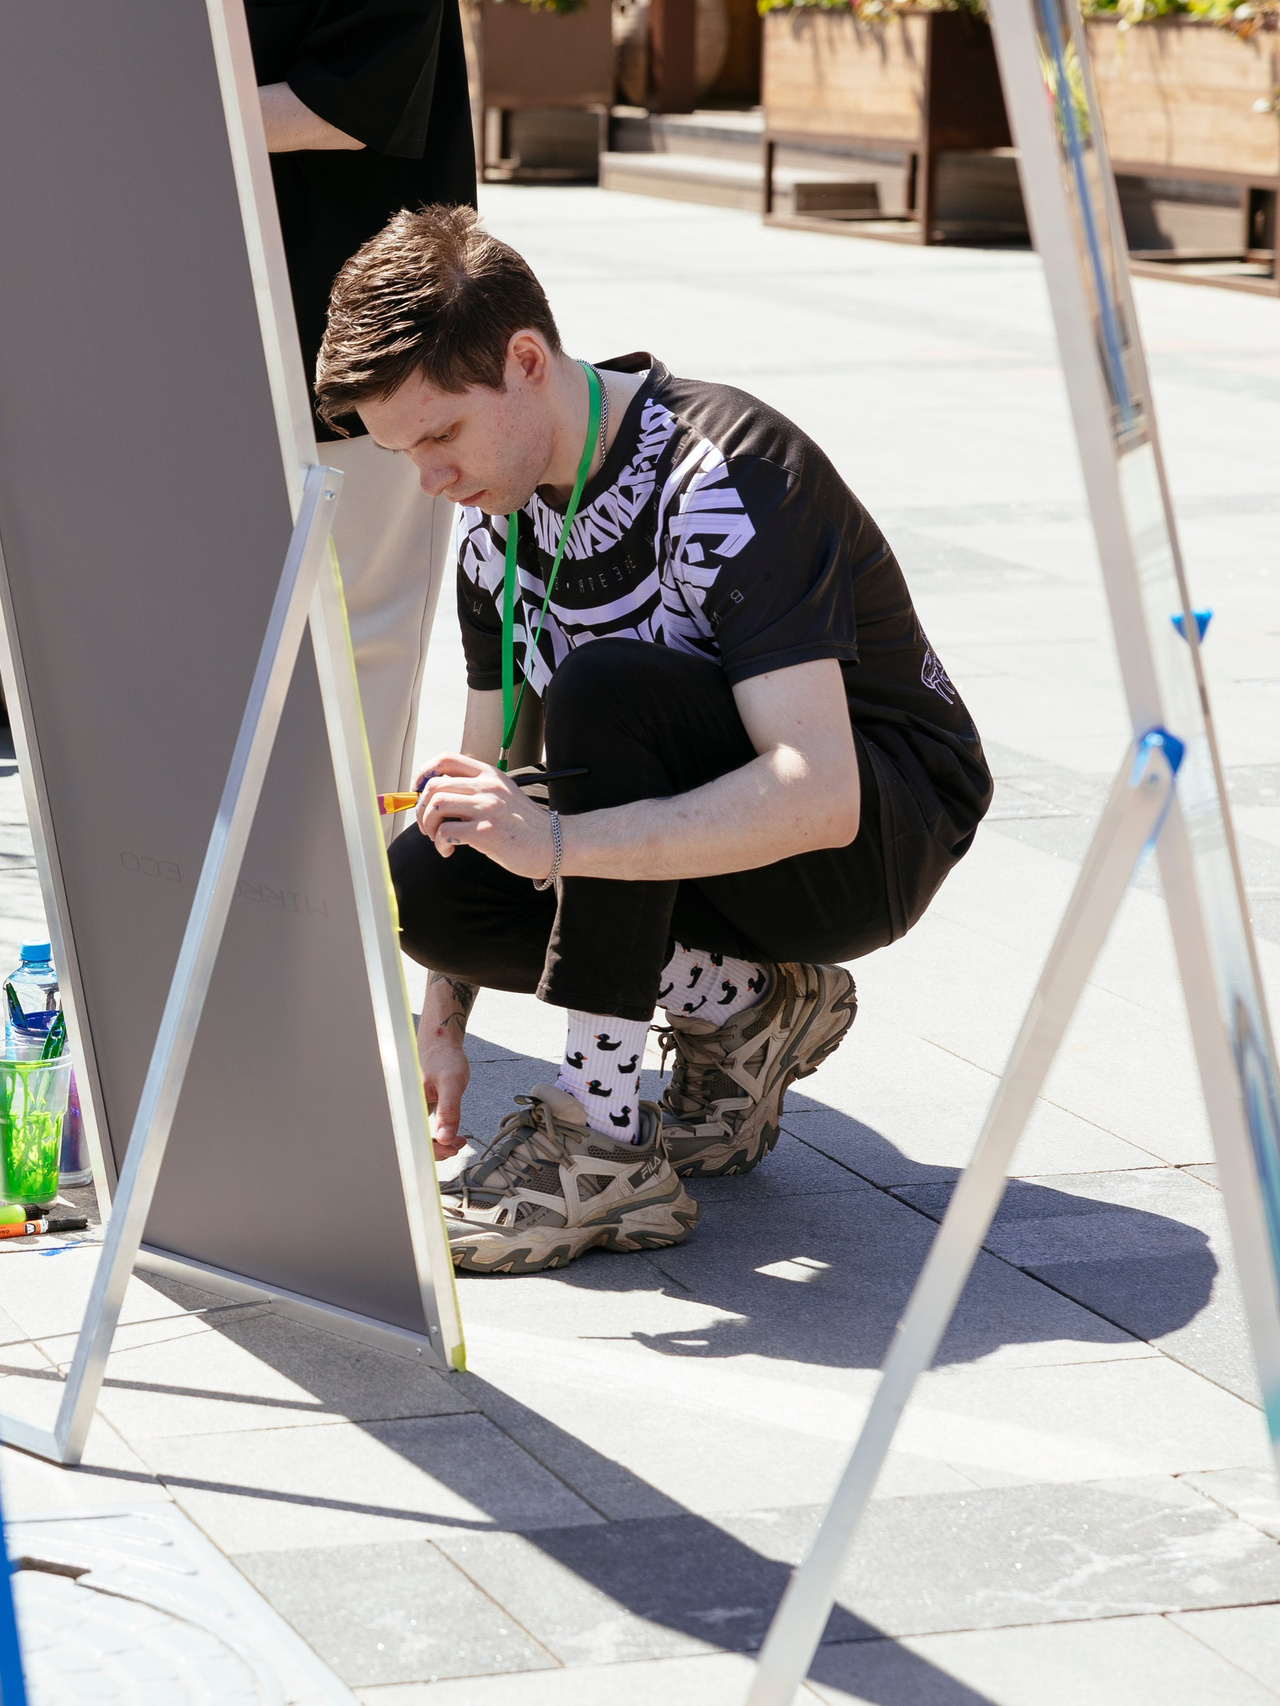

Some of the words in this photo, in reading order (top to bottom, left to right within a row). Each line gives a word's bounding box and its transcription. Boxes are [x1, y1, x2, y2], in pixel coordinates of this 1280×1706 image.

[120, 851, 182, 883] ECO
[233, 879, 329, 919] MIRR
[640, 1155, 662, 1180] FILA
